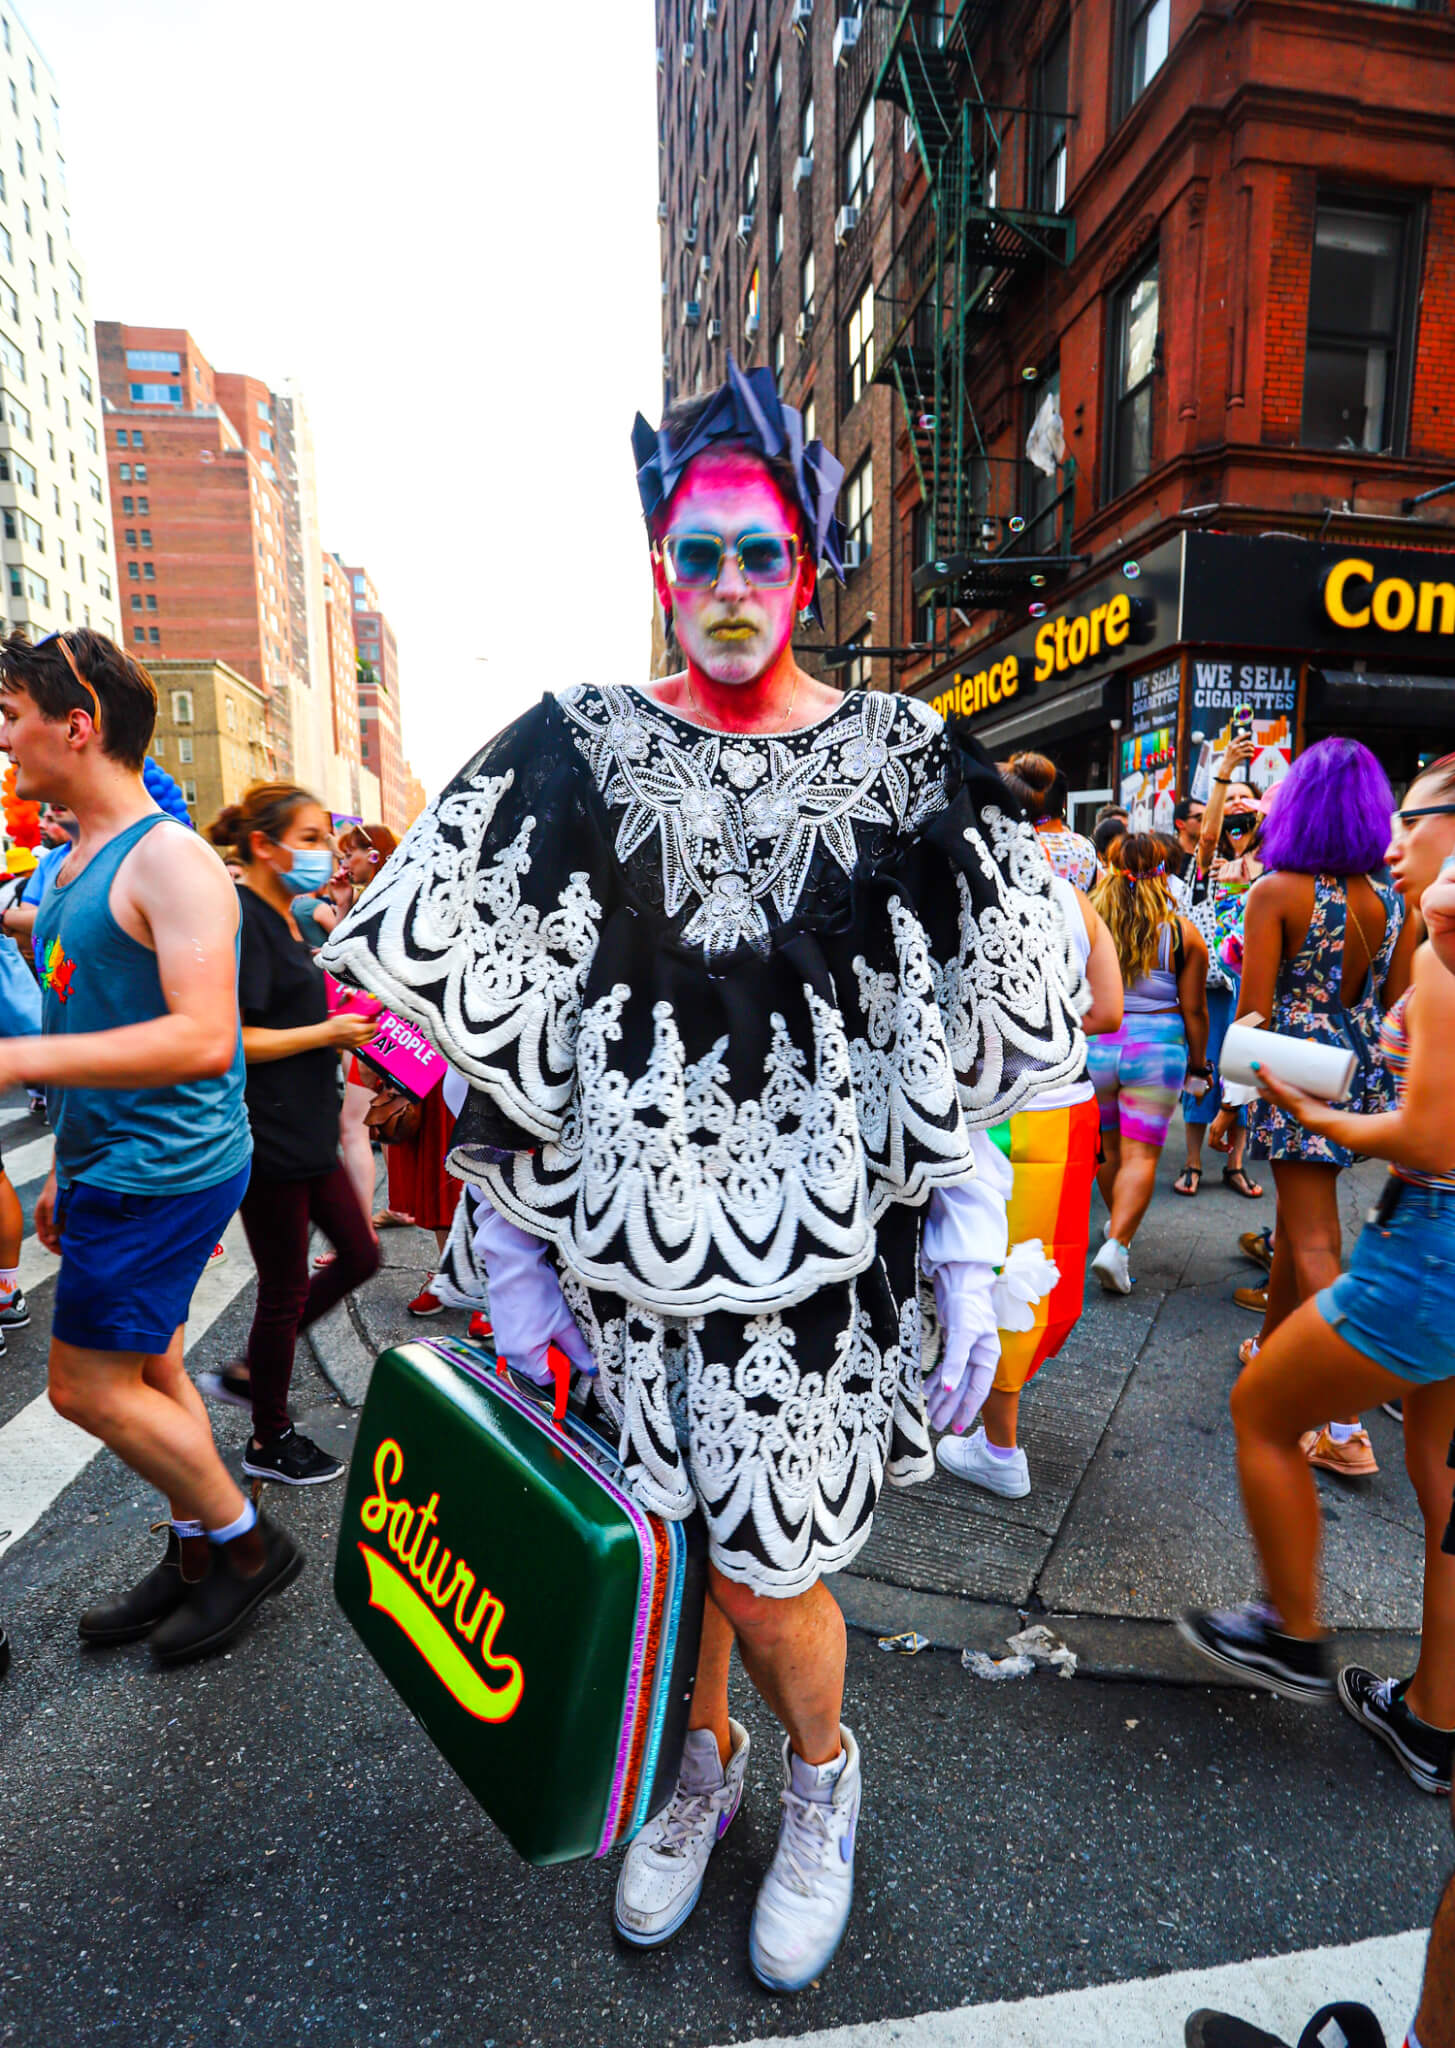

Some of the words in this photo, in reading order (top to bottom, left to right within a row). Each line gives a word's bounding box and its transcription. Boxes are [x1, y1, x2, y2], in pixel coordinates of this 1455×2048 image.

[1324, 557, 1455, 634] Con
[928, 654, 1019, 723] enience
[1034, 593, 1131, 682] Store
[1195, 663, 1233, 689] WE
[1239, 665, 1296, 691] SELL
[1132, 675, 1150, 700] WE
[1151, 663, 1180, 694] SELL
[1132, 685, 1180, 717] CIGARETTES
[1194, 689, 1295, 711] CIGARETTES
[381, 1015, 437, 1067] PEOPLE
[360, 1437, 514, 1669] Saturn
